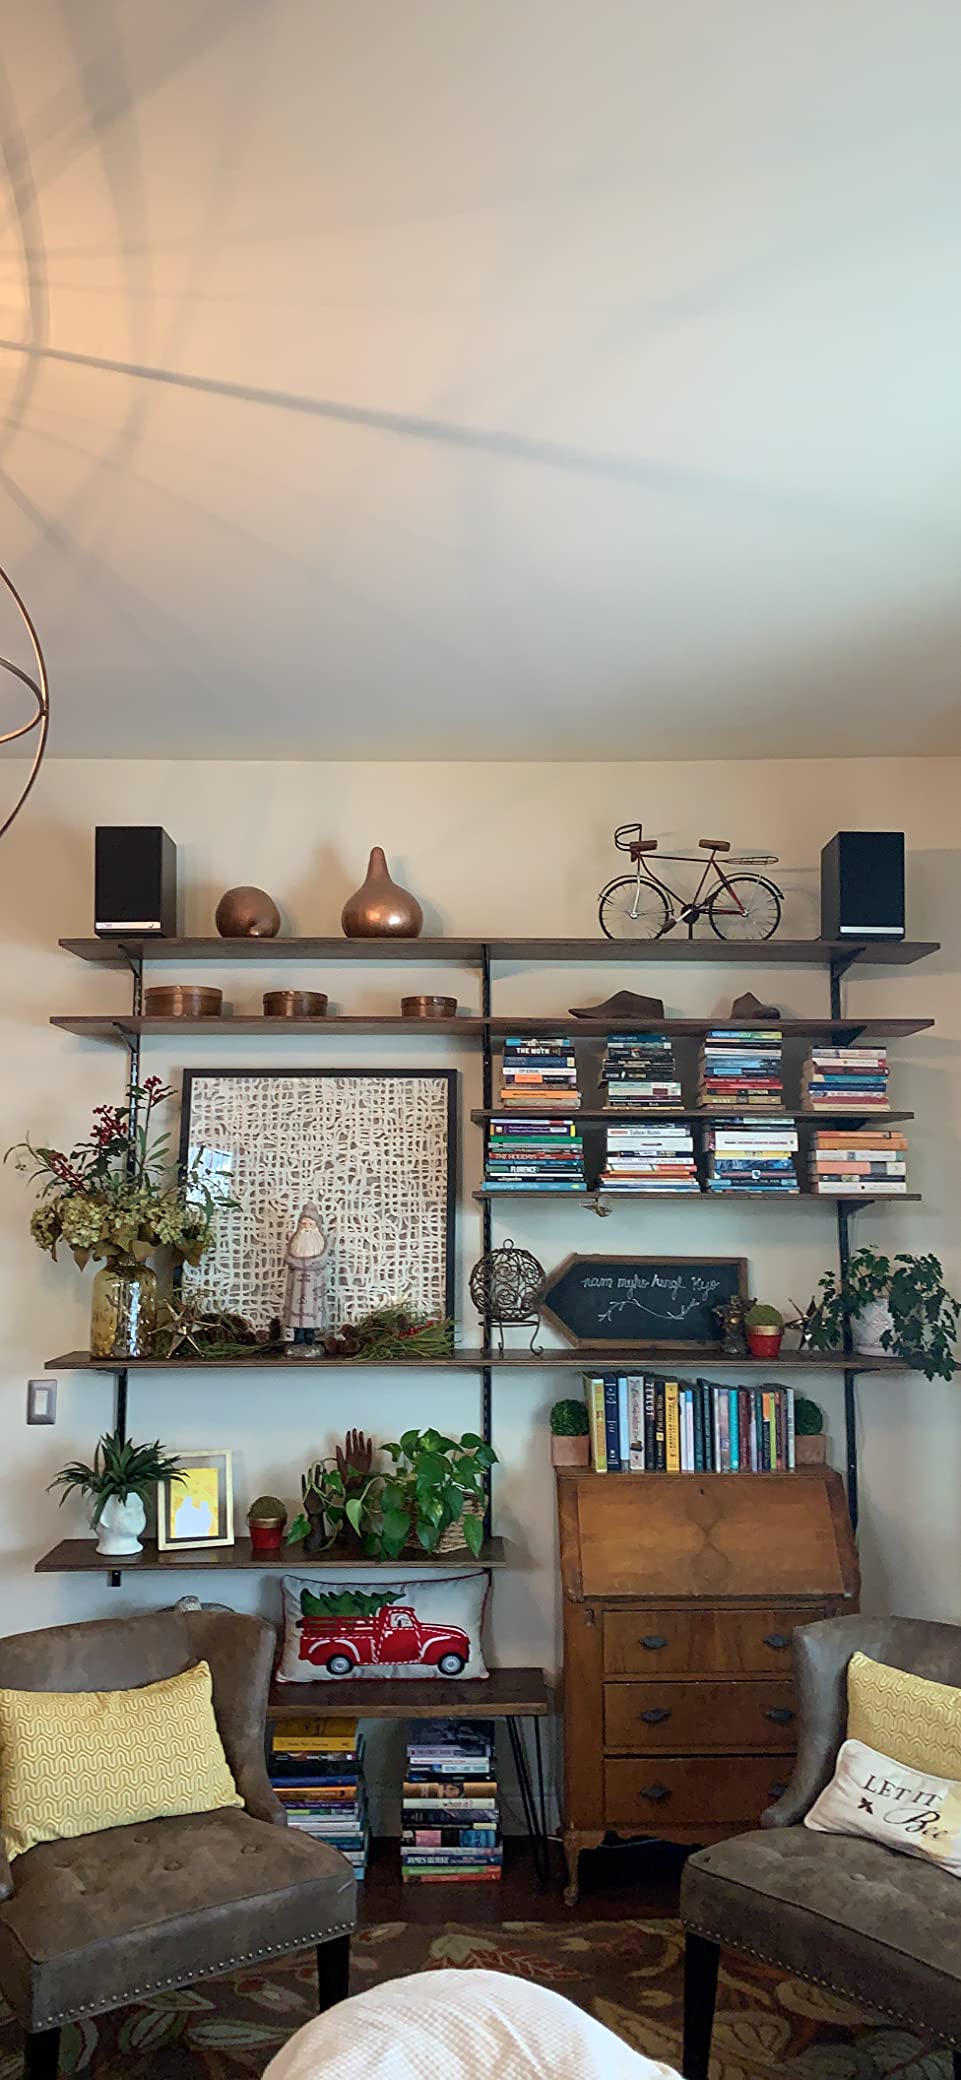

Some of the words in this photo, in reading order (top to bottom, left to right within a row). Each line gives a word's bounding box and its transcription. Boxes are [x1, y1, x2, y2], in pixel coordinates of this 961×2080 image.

[531, 1047, 550, 1055] MOTH
[510, 1165, 537, 1173] FLORENCE
[581, 1277, 612, 1289] nam
[645, 1383, 655, 1416] ZEALOT
[861, 1774, 912, 1800] LET
[912, 1791, 943, 1807] IT
[883, 1808, 948, 1839] Bee
